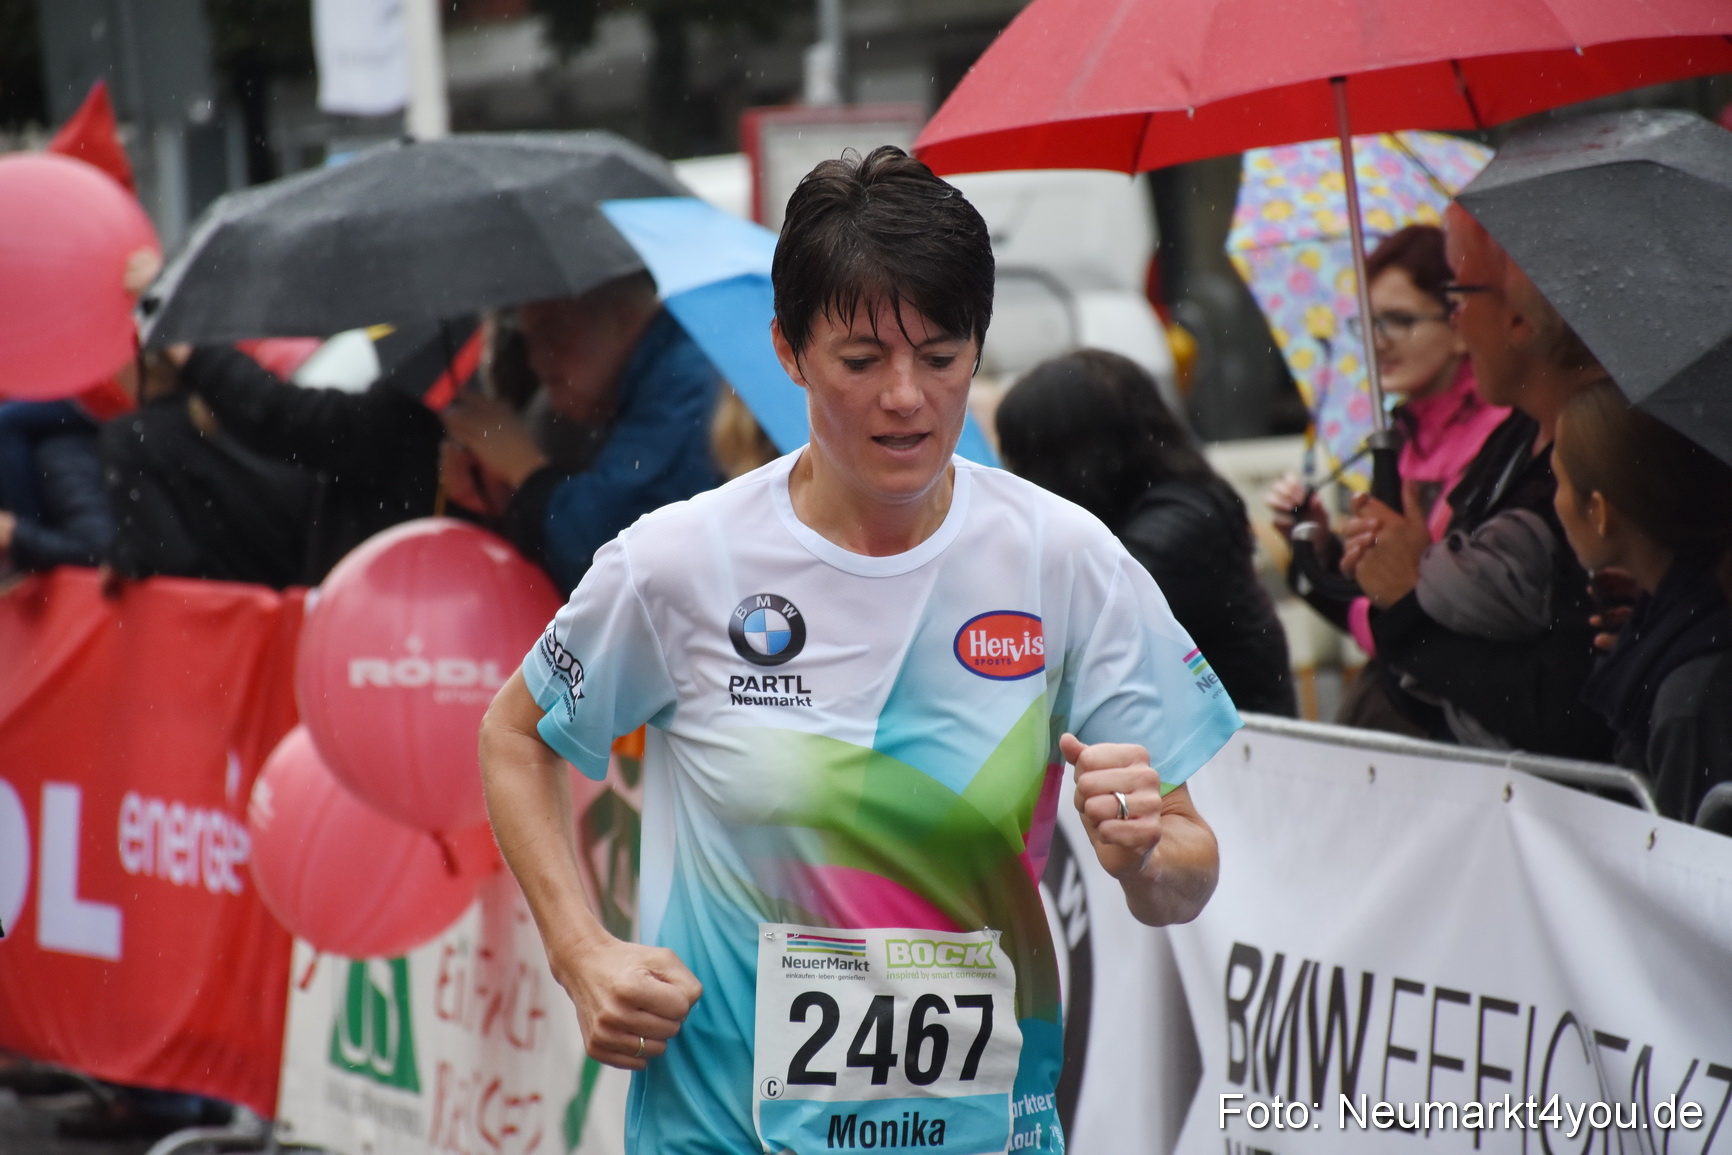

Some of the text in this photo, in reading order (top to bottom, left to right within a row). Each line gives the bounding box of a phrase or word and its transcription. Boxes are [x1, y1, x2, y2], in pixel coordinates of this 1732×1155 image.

[735, 595, 798, 621] BMW
[969, 630, 1045, 662] Hervis
[974, 658, 1012, 666] SPORTS
[728, 675, 812, 694] PARTL
[730, 693, 813, 708] Neumarkt
[782, 955, 870, 973] NeuerMarkt
[885, 938, 997, 969] BOCK
[886, 970, 997, 981] inspired by smart concepts
[787, 991, 994, 1086] 2467
[1224, 941, 1375, 1120] BMW
[827, 1112, 947, 1149] Monika
